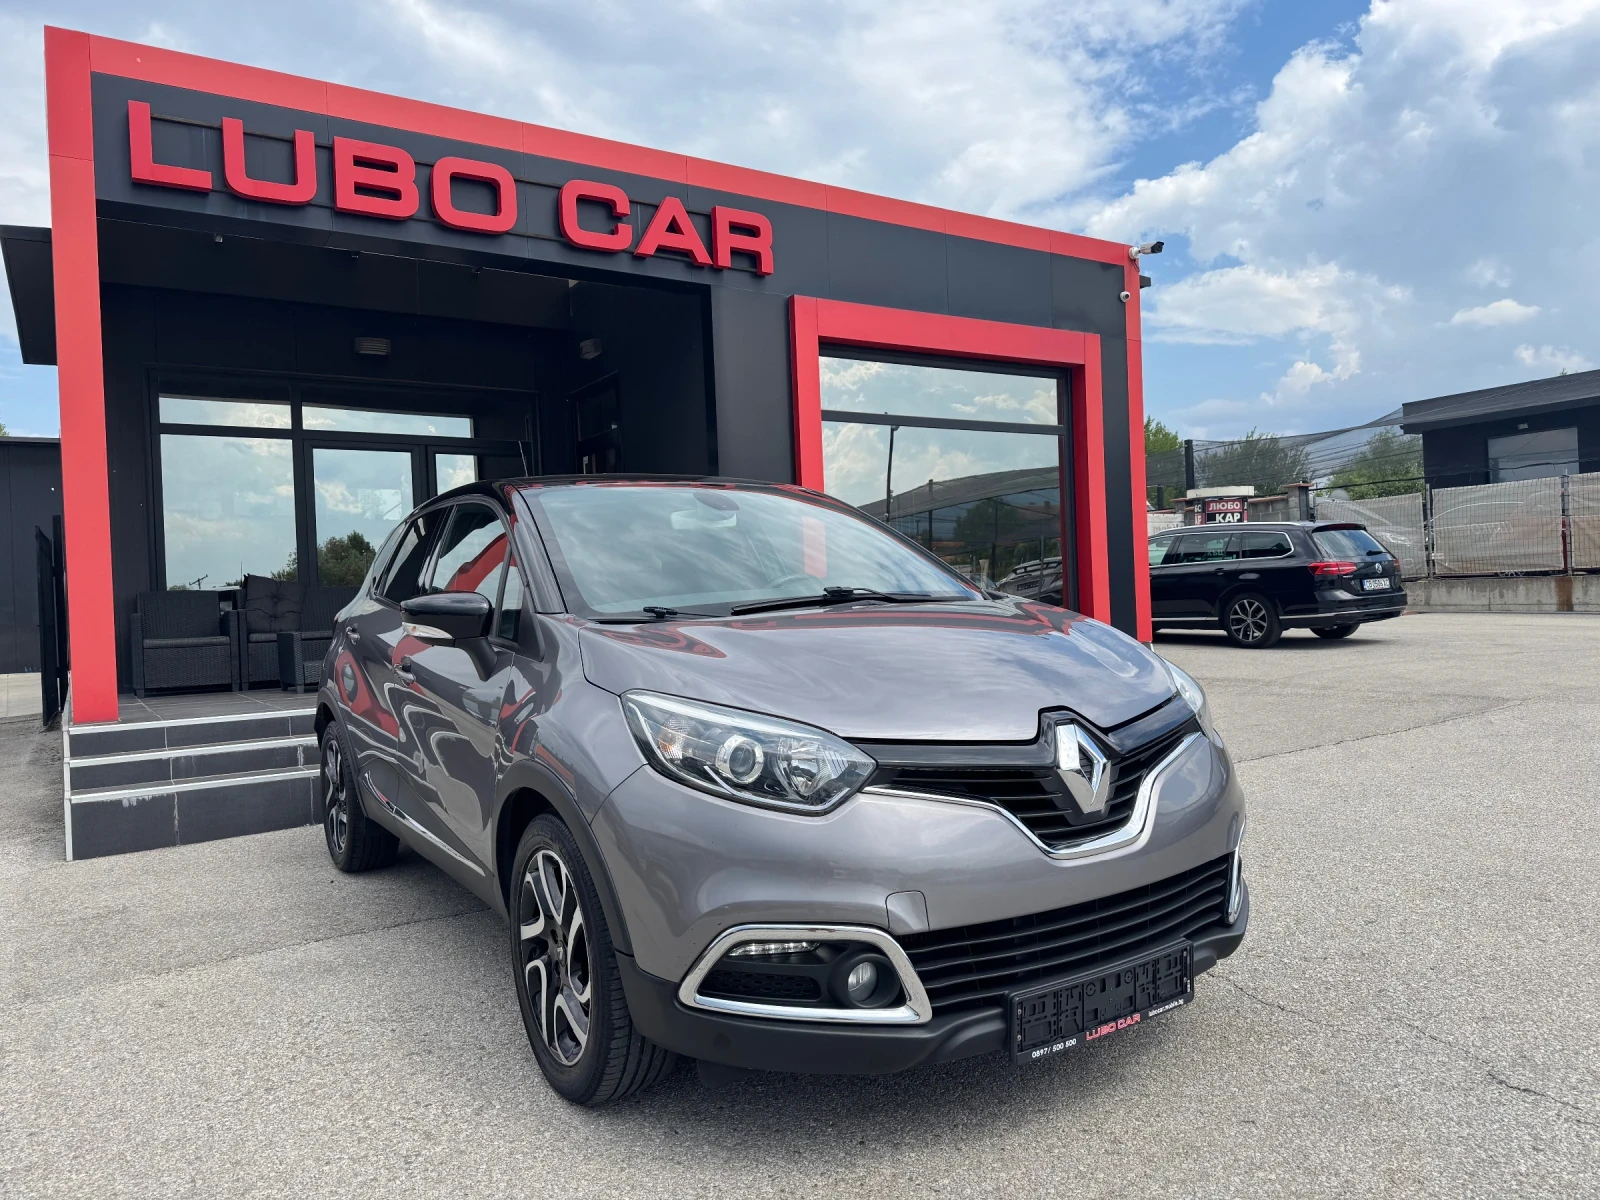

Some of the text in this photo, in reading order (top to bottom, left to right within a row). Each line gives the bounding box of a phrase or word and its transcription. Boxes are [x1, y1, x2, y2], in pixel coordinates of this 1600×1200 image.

[128, 100, 774, 276] LUBO CAR
[1208, 501, 1241, 511] ЛЮБО
[1215, 512, 1241, 523] КАР
[1052, 1043, 1064, 1052] 500
[1065, 1038, 1077, 1048] 500
[1086, 1024, 1116, 1040] LUBO
[1117, 1013, 1141, 1030] CAR
